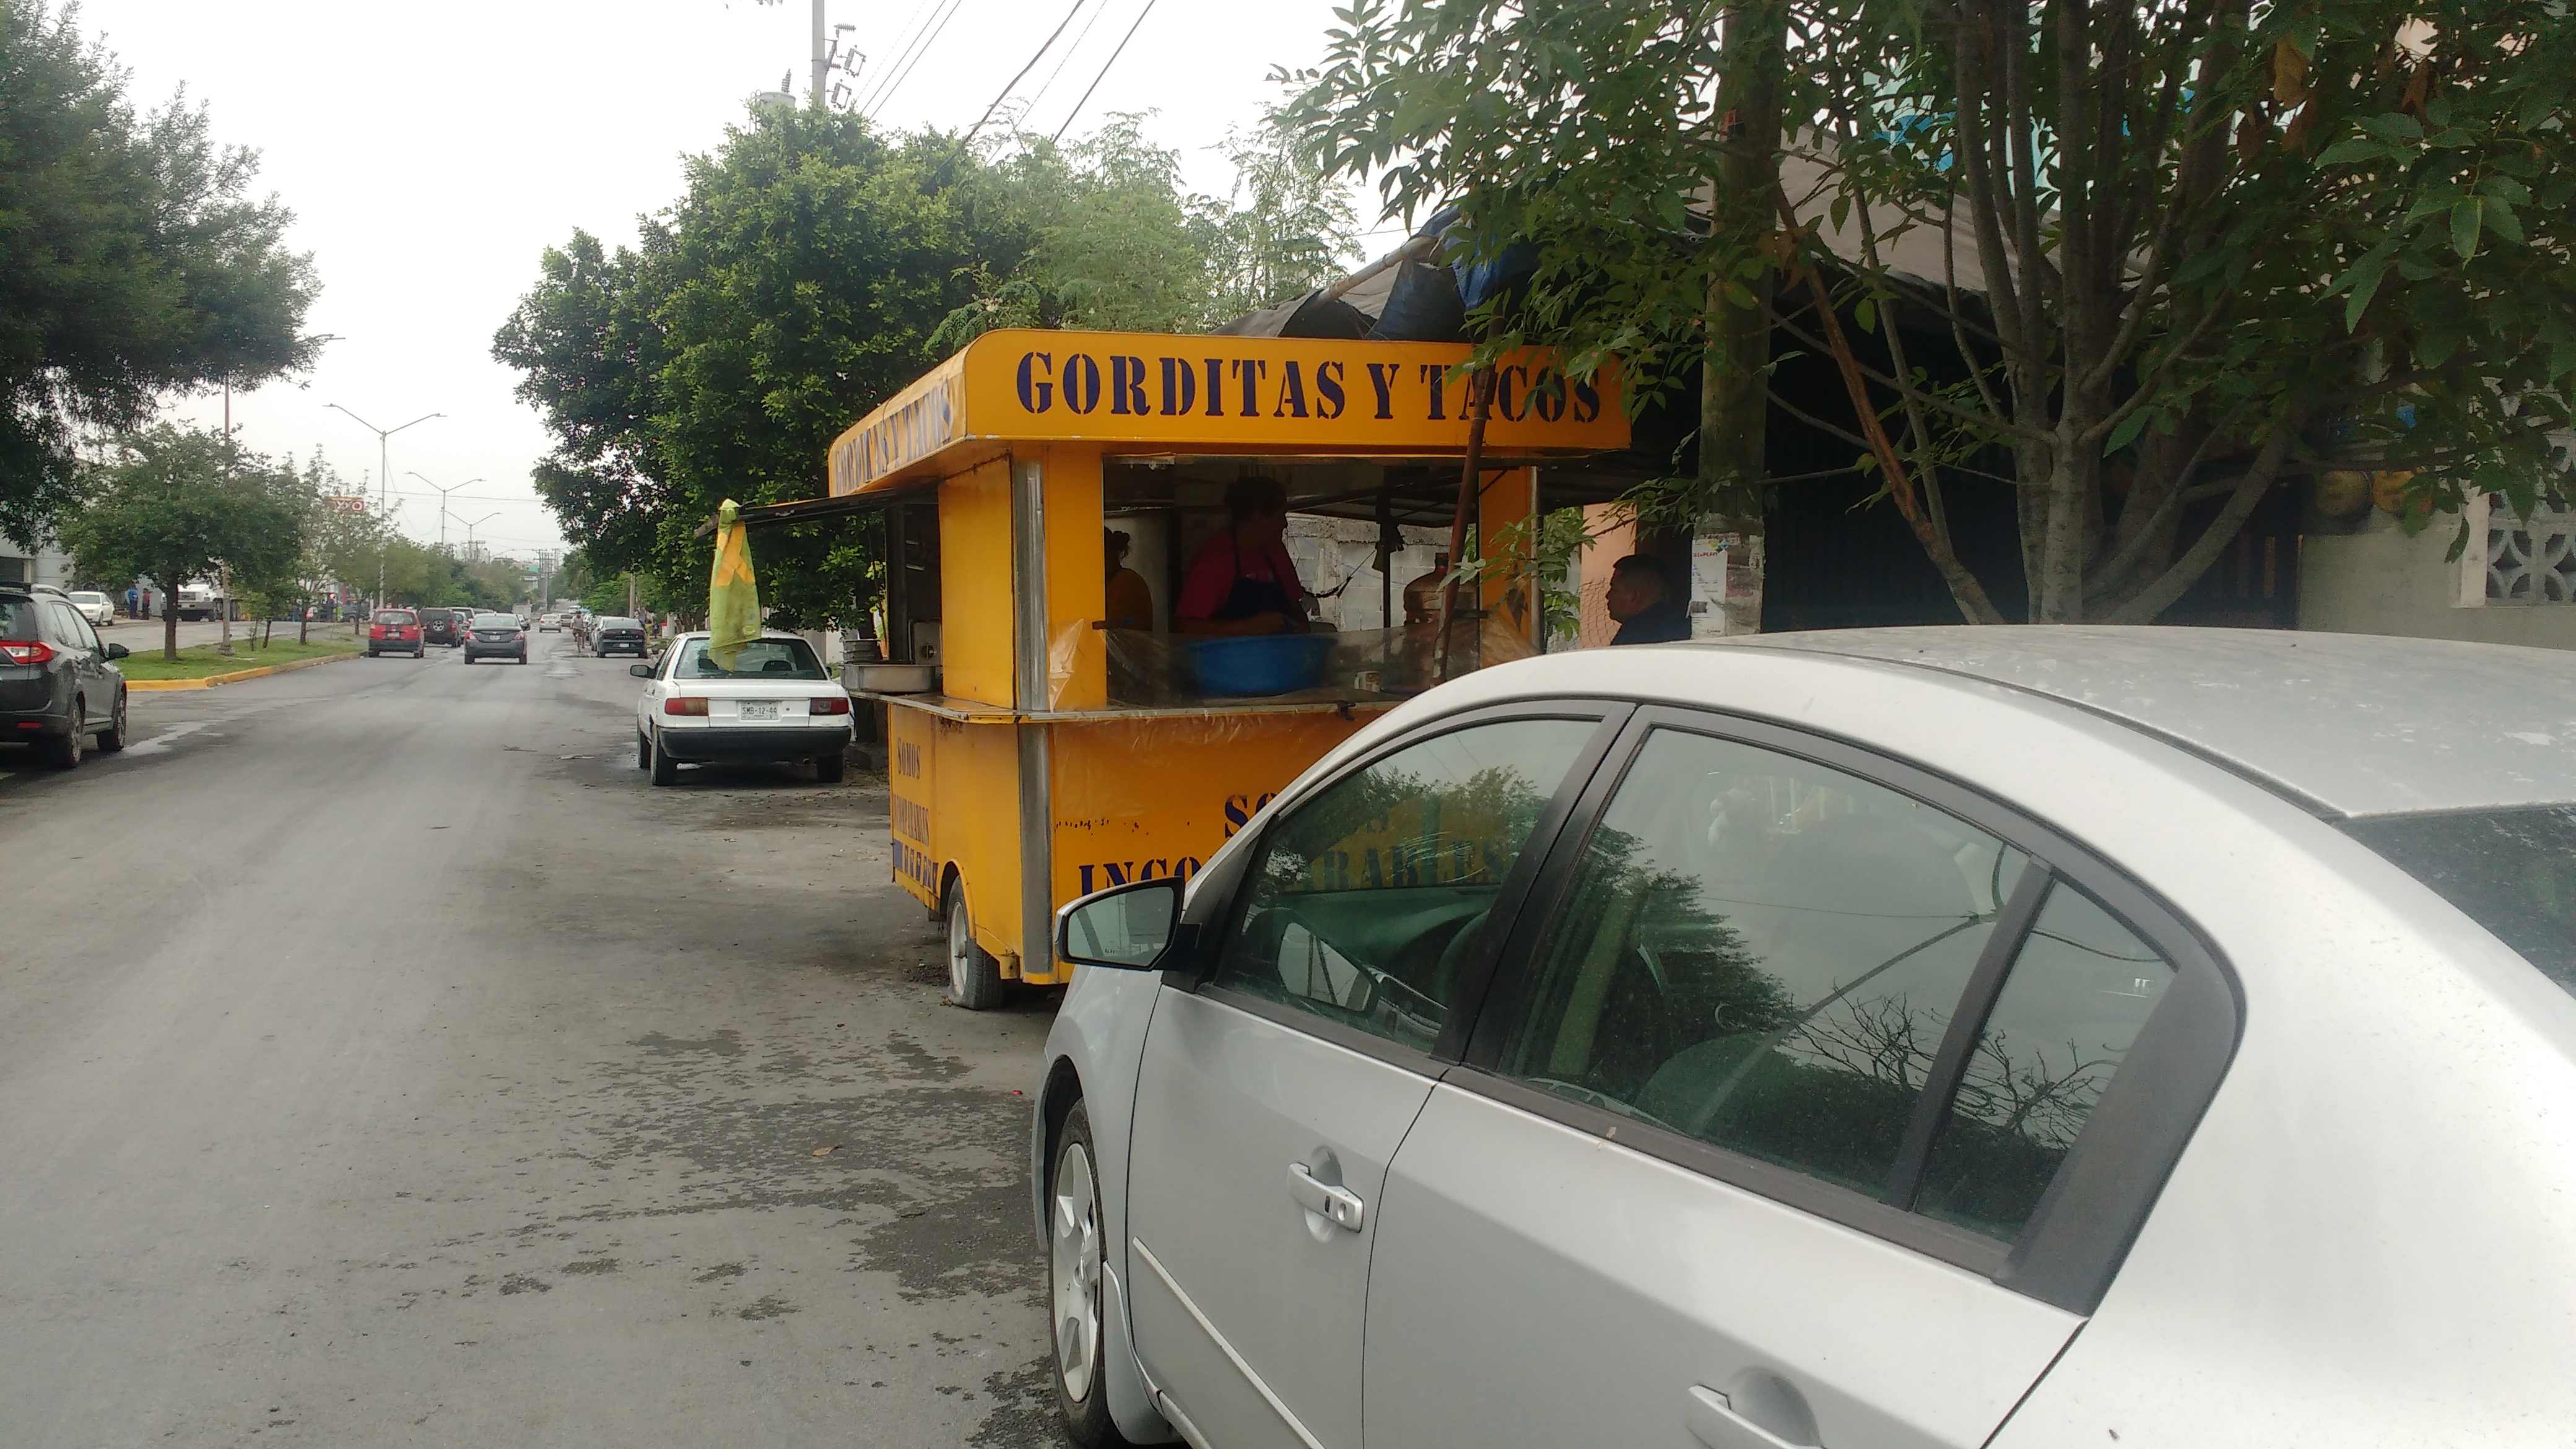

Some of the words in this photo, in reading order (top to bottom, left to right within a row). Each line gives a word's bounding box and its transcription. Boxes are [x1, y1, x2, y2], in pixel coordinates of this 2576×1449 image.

[902, 374, 954, 464] TACOS
[1016, 352, 1345, 419] GORDITAS
[1367, 363, 1399, 419] Y
[1420, 364, 1601, 422] TACOS
